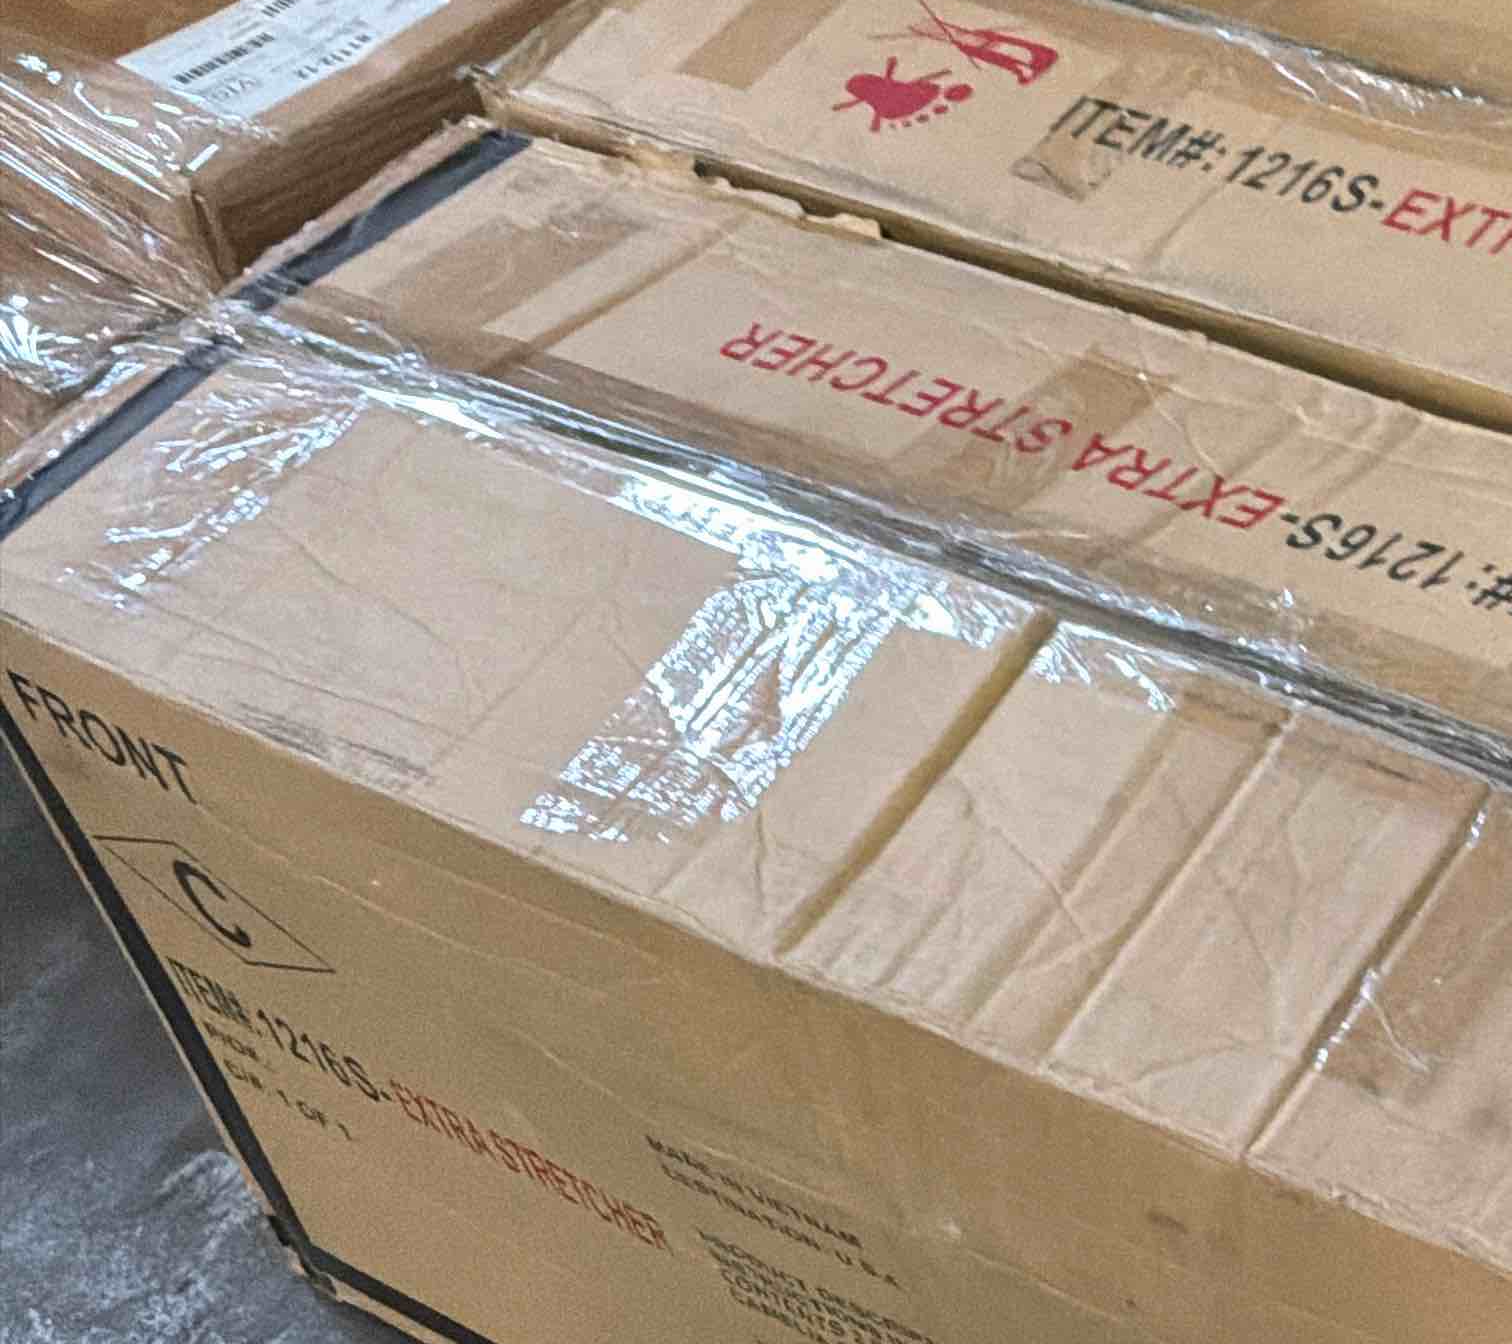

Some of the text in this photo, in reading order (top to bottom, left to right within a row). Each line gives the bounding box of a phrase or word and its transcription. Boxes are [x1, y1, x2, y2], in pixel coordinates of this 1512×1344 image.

[719, 320, 1073, 455] STRETCHER
[7, 670, 197, 805] FRONT
[485, 1128, 675, 1257] STRETCHER
